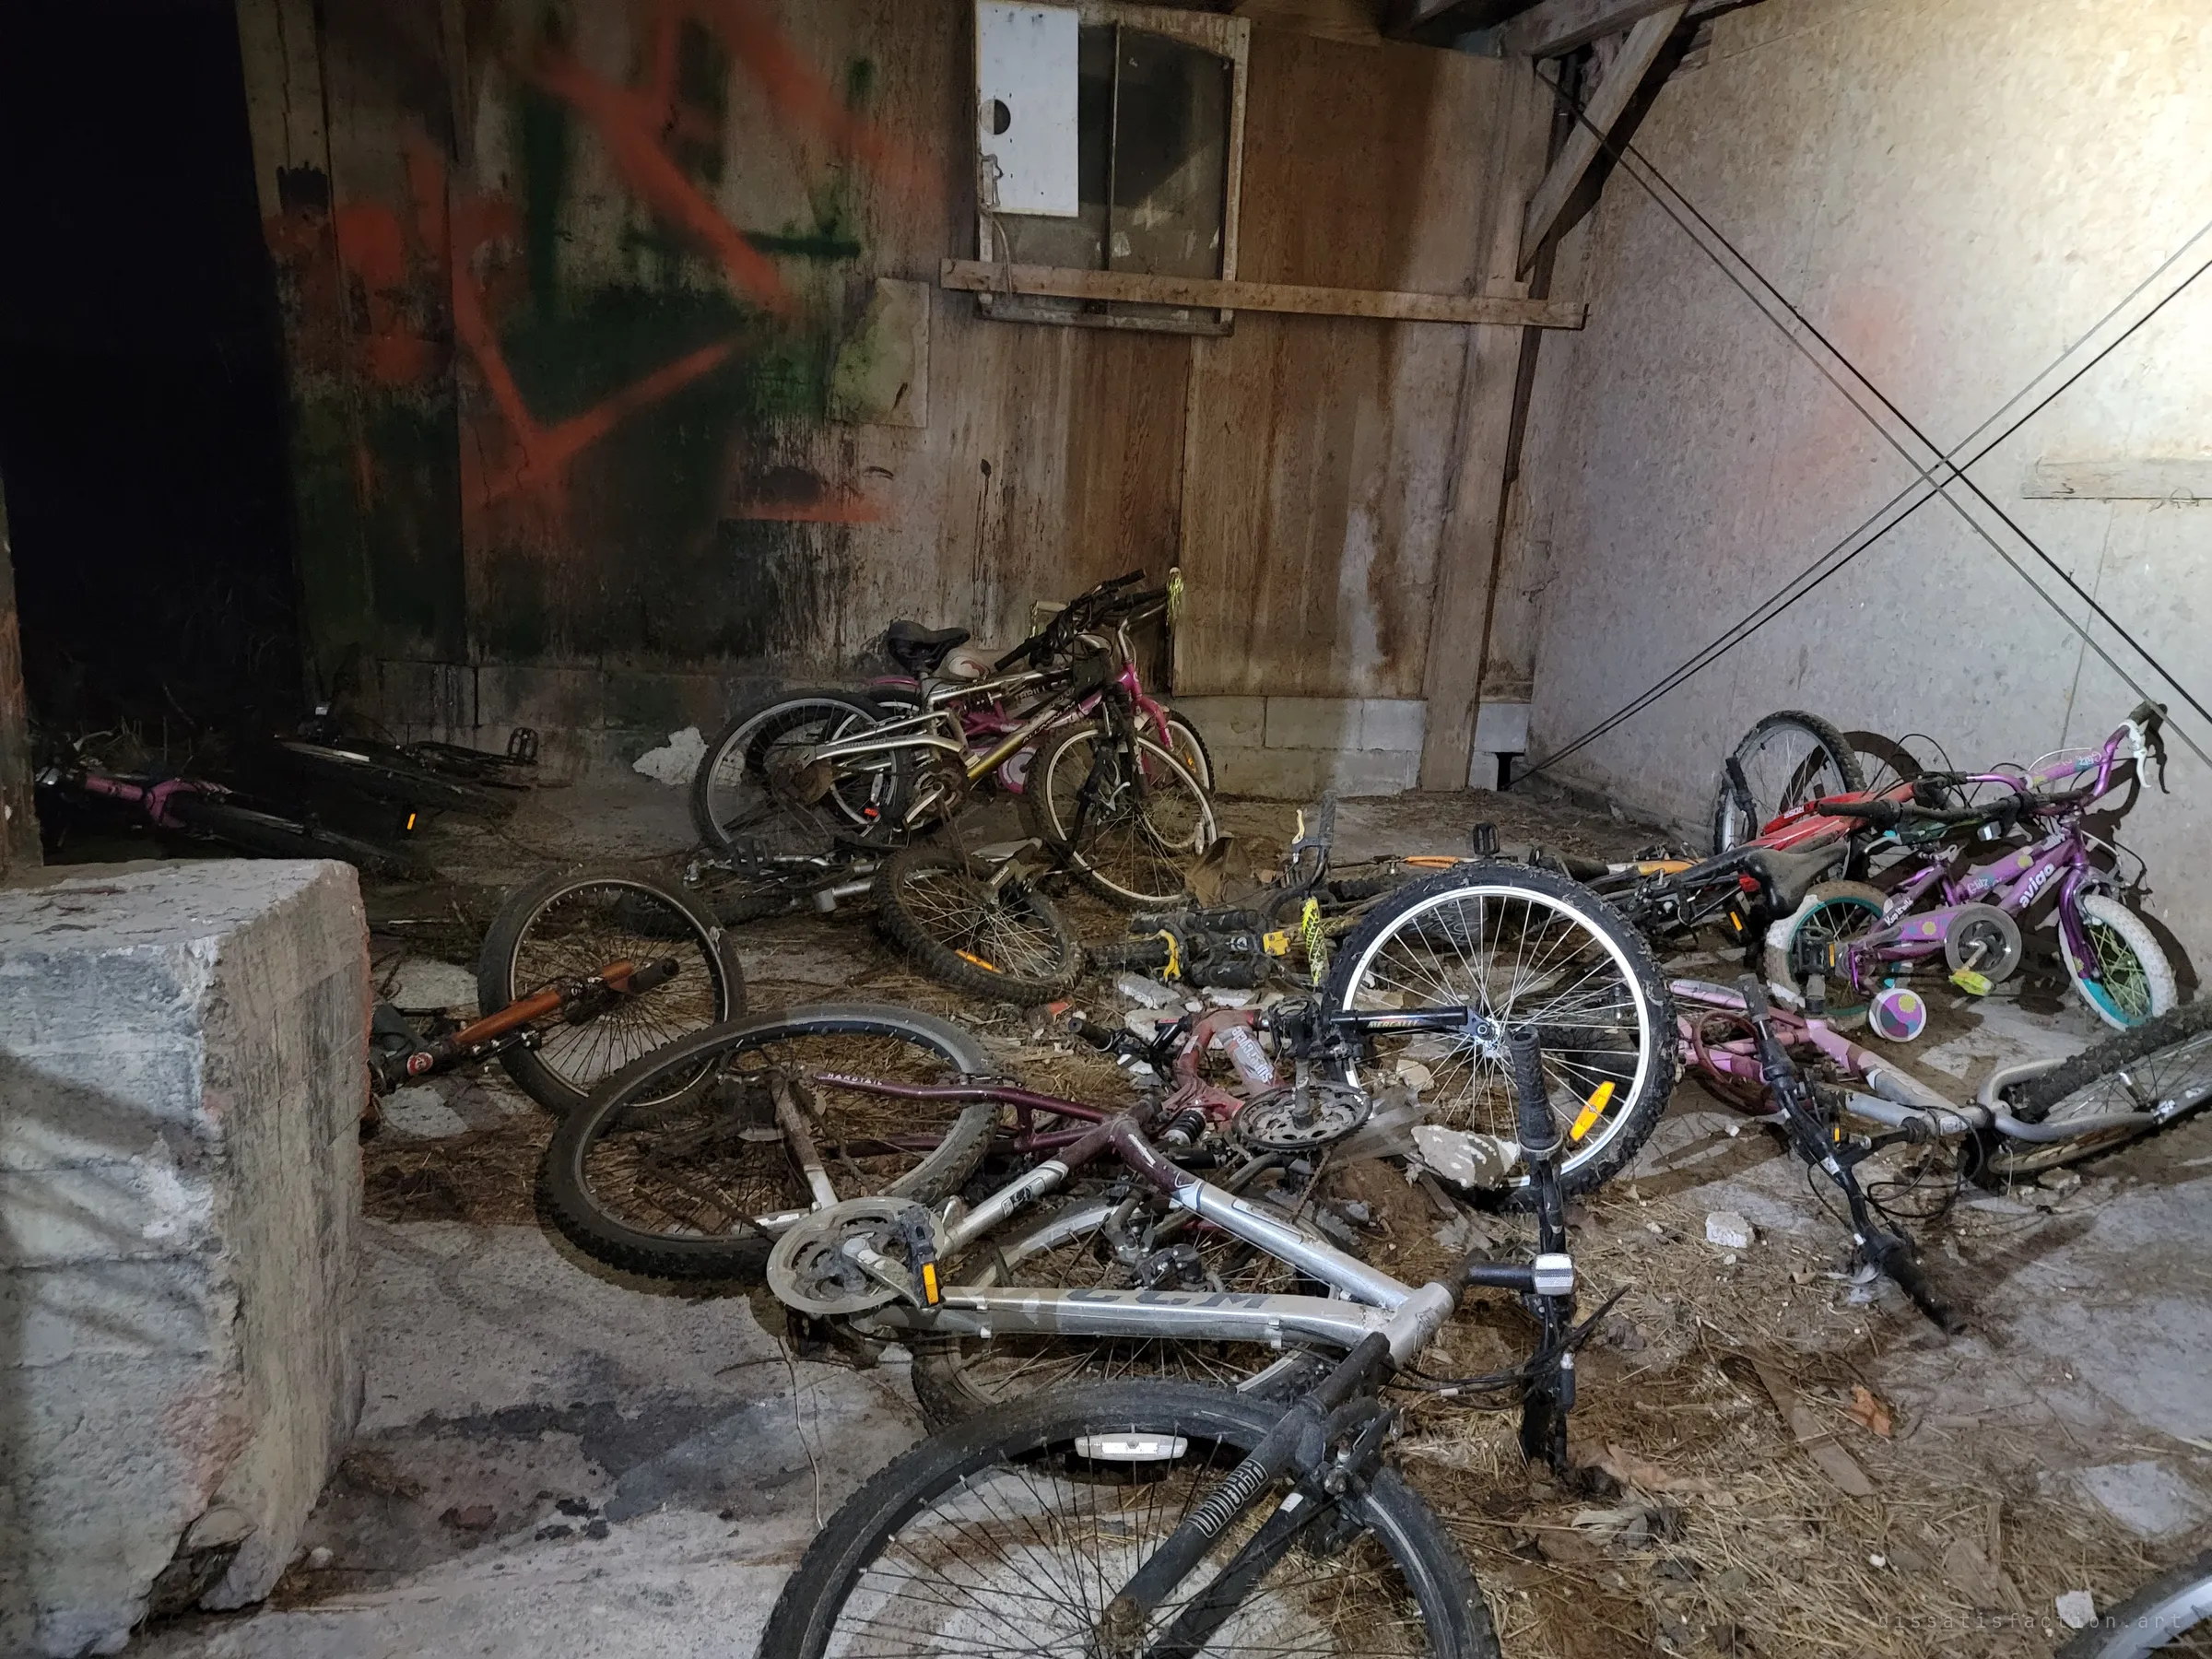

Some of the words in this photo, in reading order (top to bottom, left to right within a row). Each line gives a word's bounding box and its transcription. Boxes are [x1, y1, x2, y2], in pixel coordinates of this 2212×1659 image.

[2019, 863, 2055, 909] avigo
[827, 1073, 884, 1086] HARDTAIL
[1066, 1289, 1269, 1309] CCM
